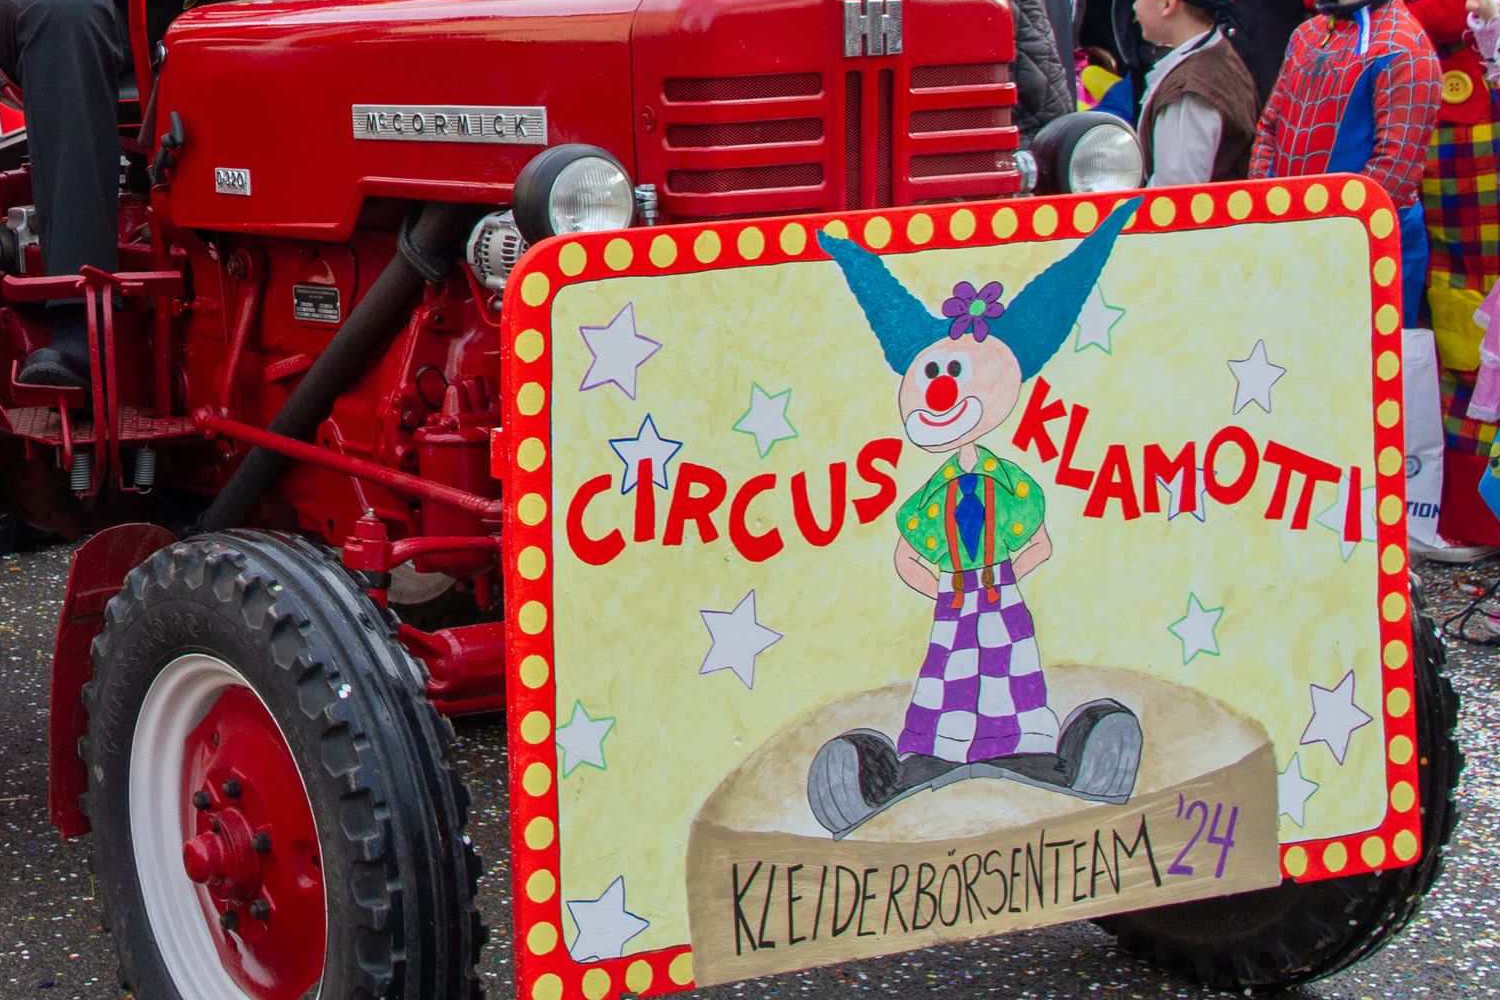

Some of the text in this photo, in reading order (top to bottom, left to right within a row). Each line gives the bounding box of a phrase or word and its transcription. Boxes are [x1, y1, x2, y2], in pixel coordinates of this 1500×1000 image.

[566, 375, 1362, 566] CIRCUS KLAMOTTI
[732, 813, 1162, 957] KLEIDERBÖRSENTEAM
